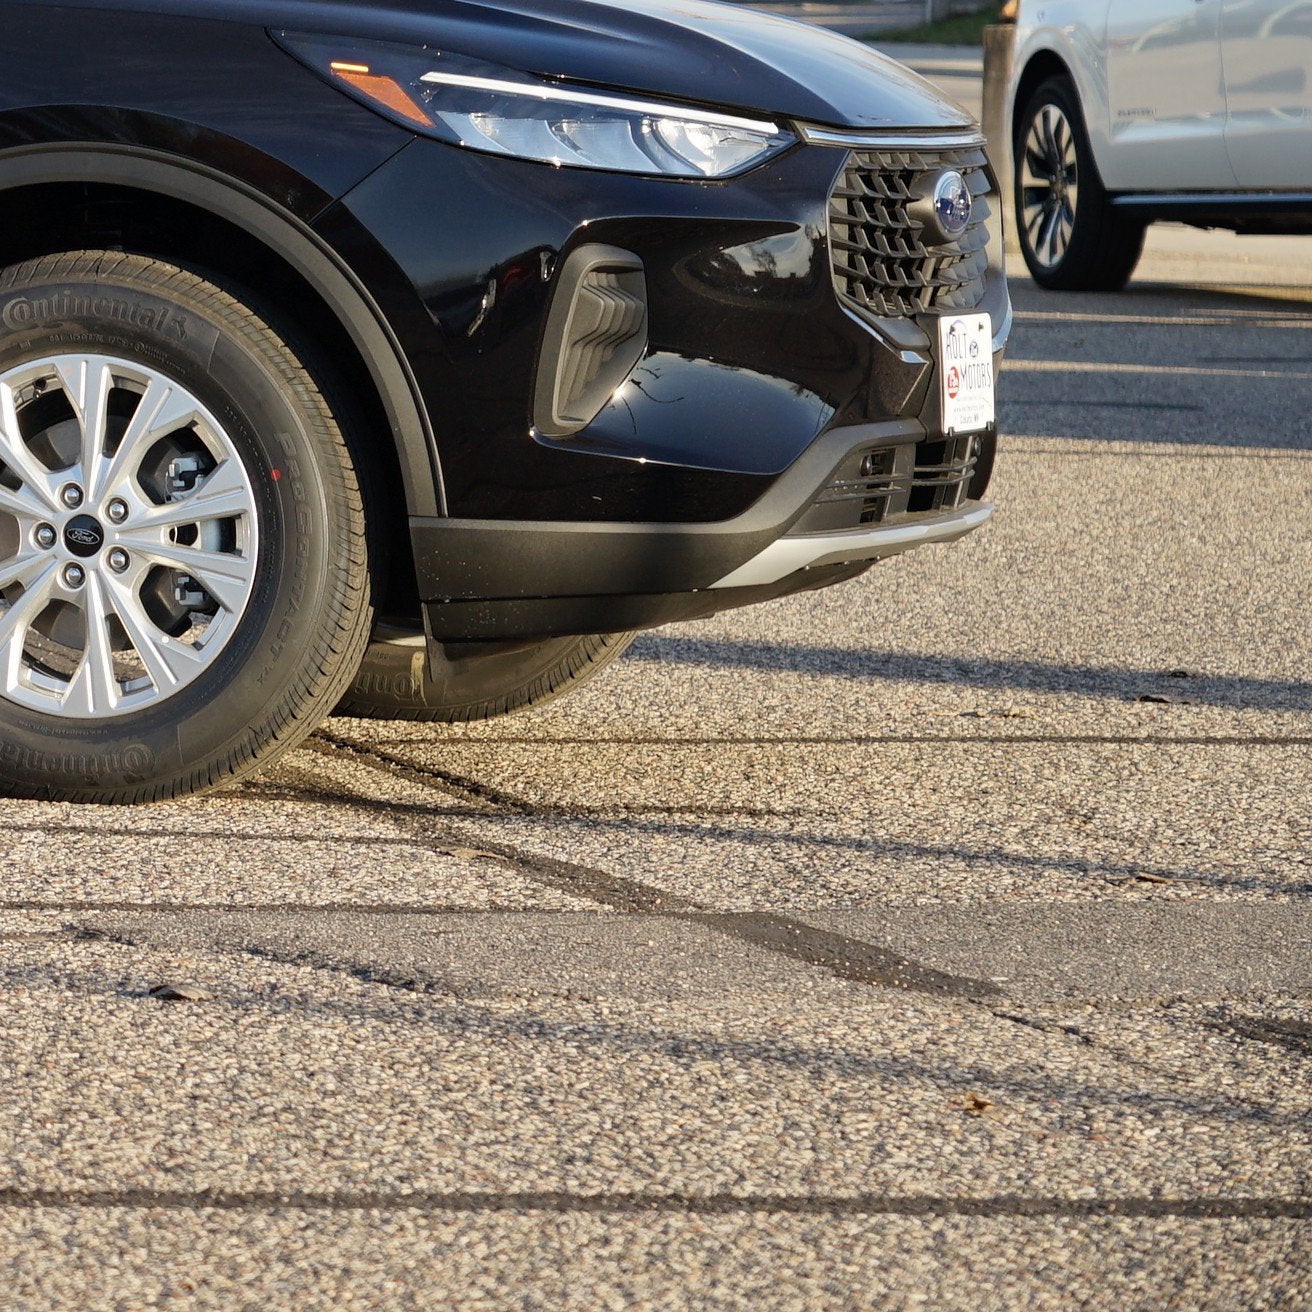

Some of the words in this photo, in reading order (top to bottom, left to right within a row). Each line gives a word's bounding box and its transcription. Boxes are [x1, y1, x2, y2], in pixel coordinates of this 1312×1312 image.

[2, 290, 169, 331] Continental
[960, 361, 992, 390] MOTORS
[71, 530, 94, 542] Ford
